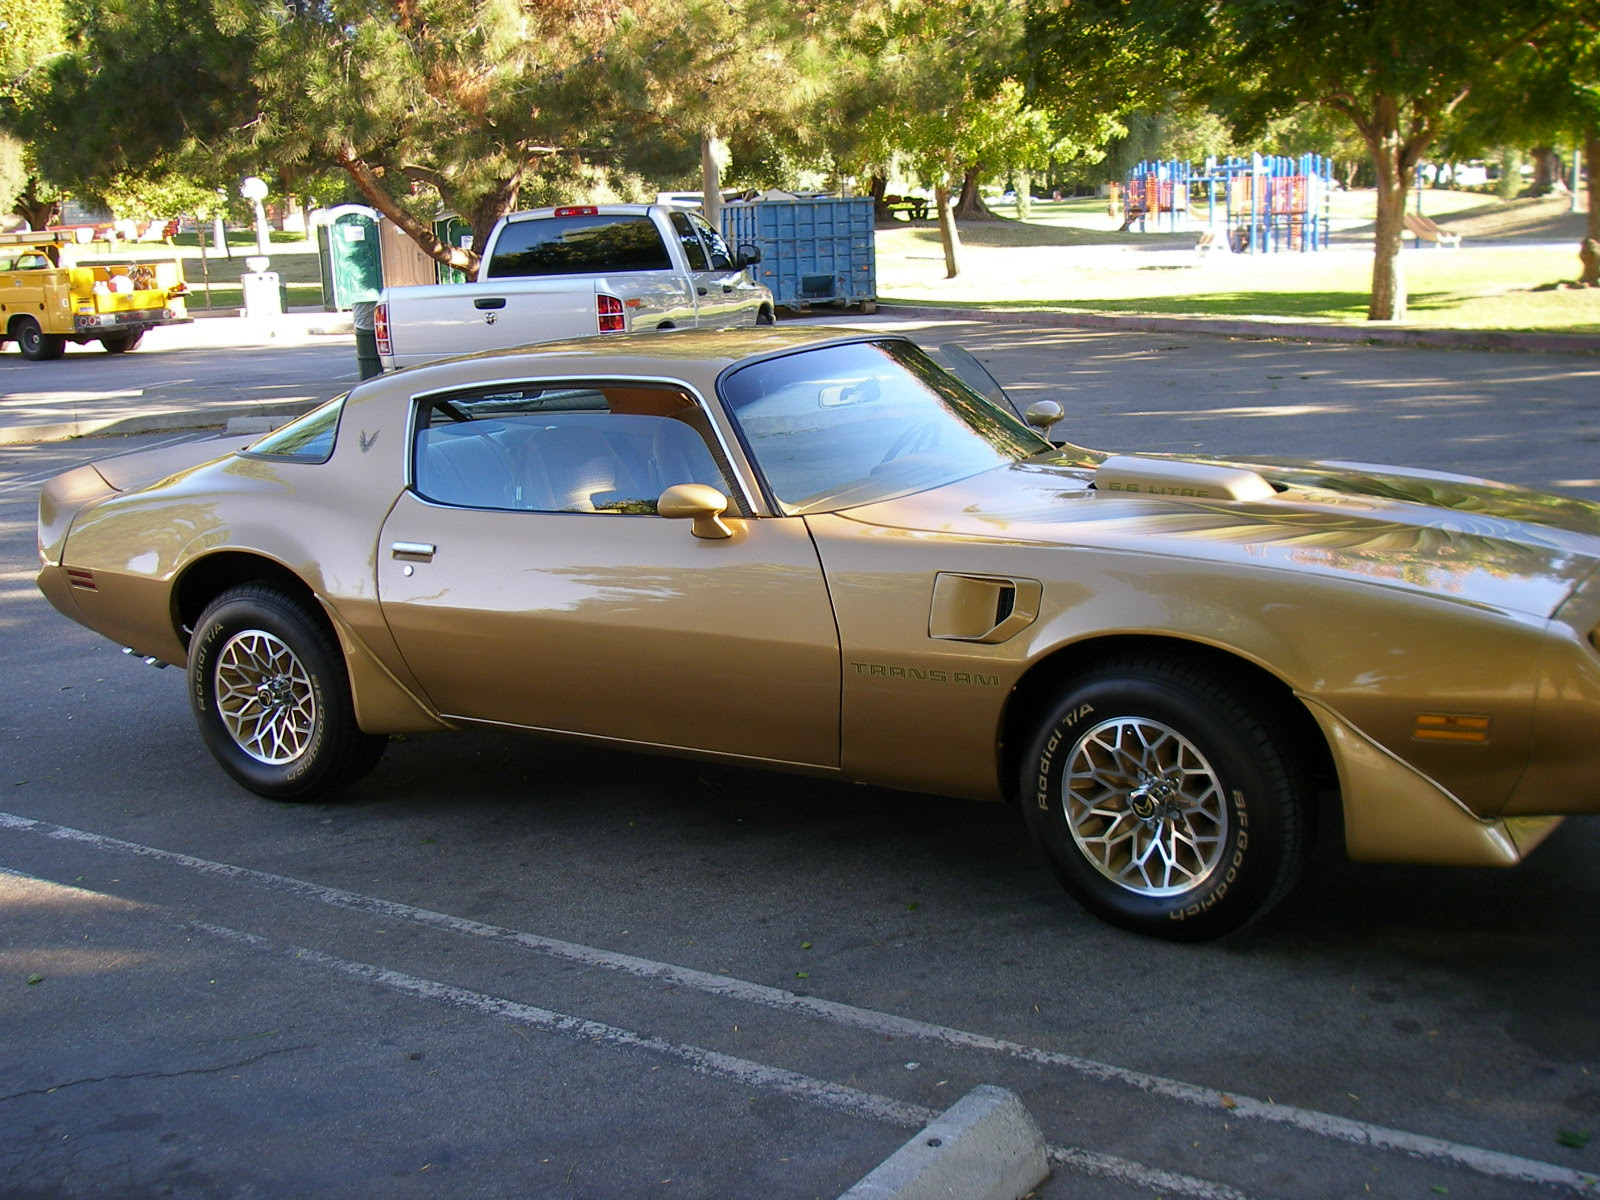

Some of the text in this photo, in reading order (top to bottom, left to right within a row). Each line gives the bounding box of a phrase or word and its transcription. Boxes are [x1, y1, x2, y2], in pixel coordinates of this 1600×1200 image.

[196, 624, 225, 712] Radial T/A
[850, 662, 1000, 687] TRANS AM
[1037, 702, 1096, 811] Radial T/A
[1169, 790, 1249, 921] BFGoodrich
